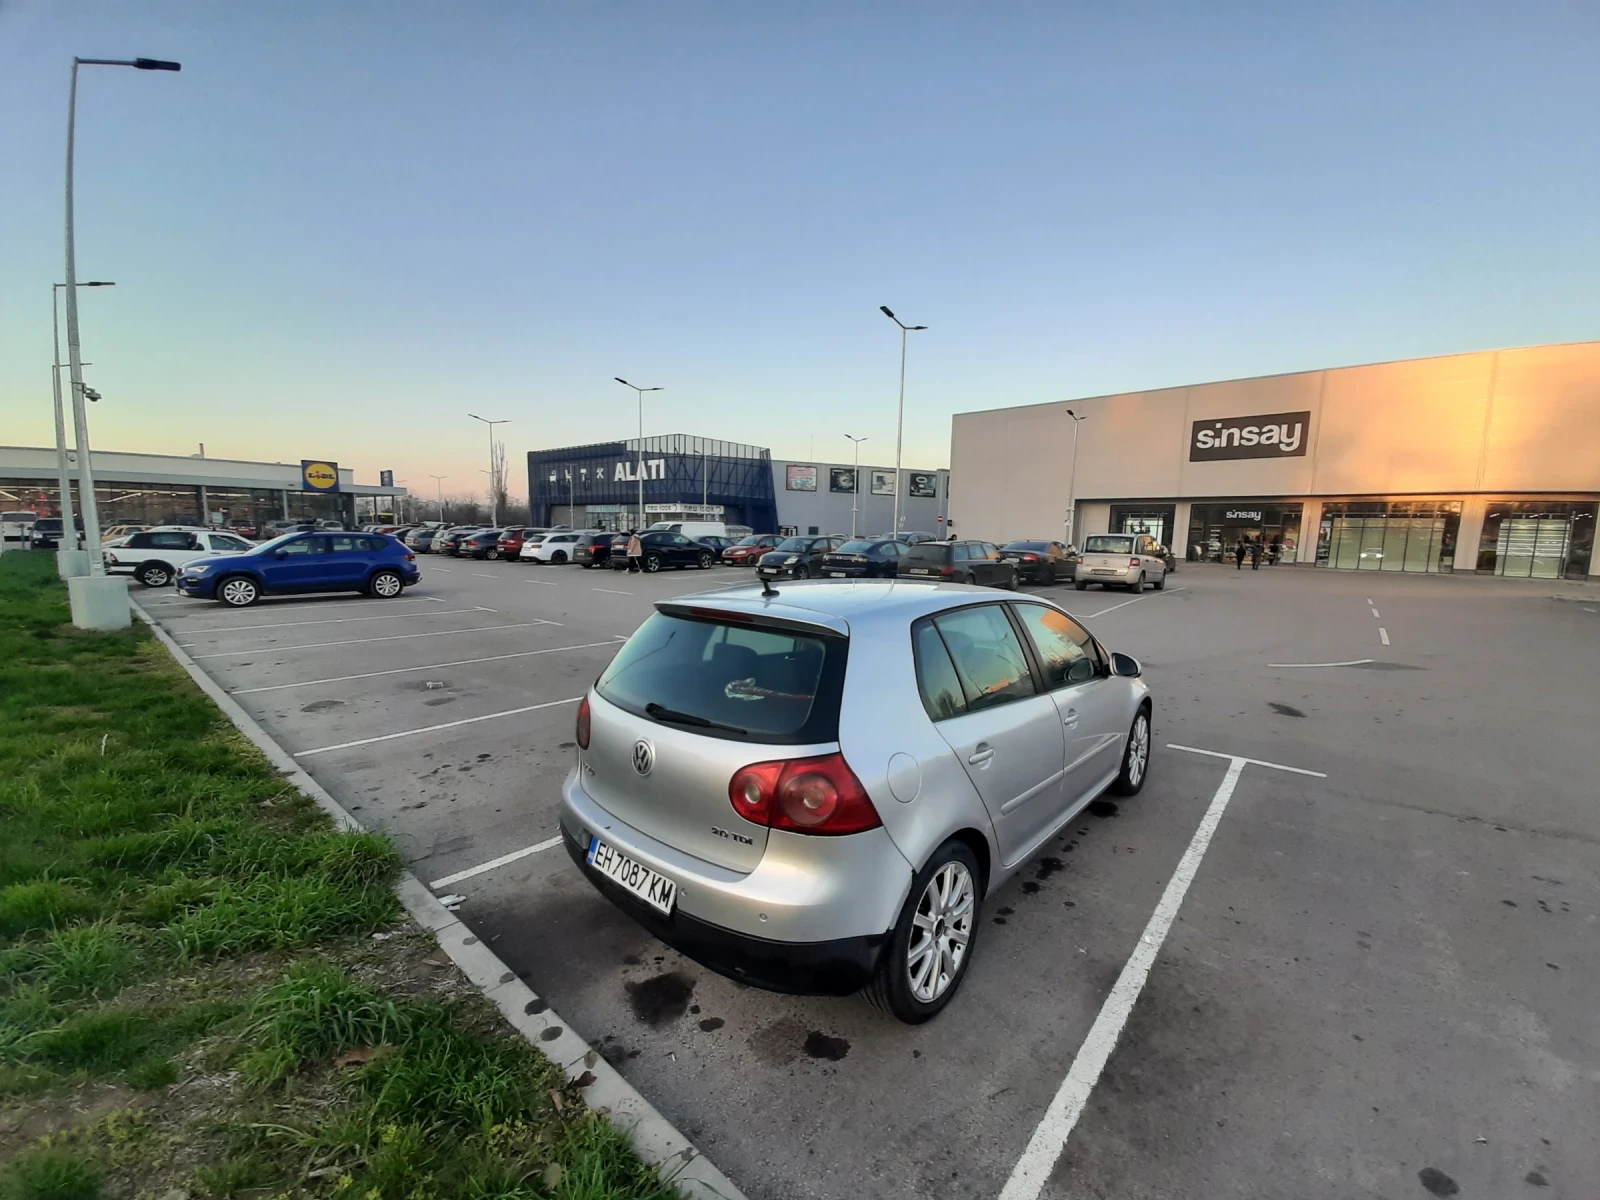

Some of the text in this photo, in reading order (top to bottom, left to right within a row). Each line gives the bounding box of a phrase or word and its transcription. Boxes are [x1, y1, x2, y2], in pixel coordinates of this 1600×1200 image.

[1196, 422, 1302, 452] sinsay
[614, 459, 665, 482] ALATI
[1226, 509, 1261, 521] sinsay
